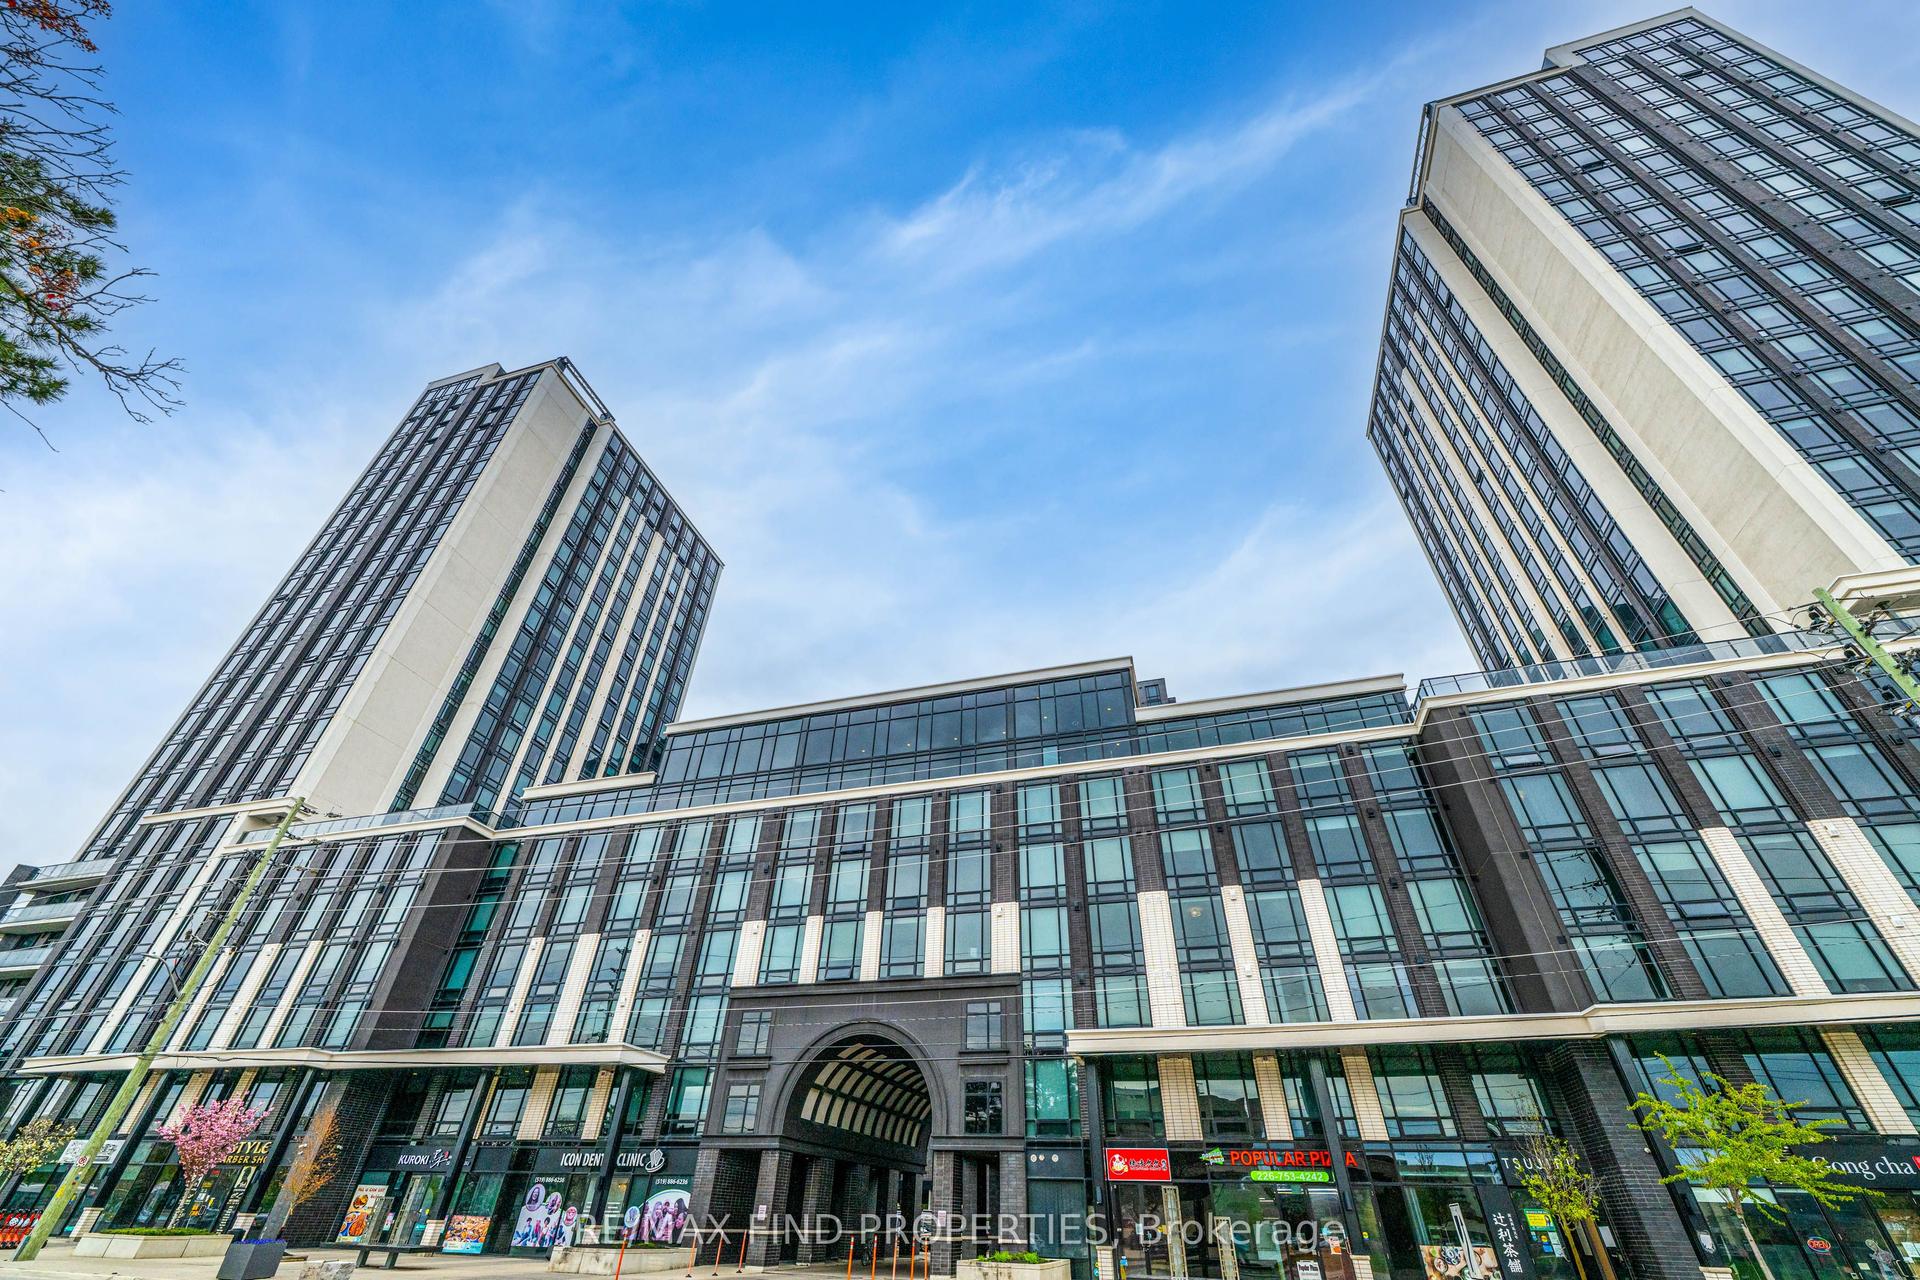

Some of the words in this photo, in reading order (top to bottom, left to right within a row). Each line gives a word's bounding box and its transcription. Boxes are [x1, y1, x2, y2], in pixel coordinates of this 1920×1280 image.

[398, 1155, 430, 1165] KUROKI
[560, 1153, 581, 1166] ICON
[582, 1153, 604, 1166] DENT
[616, 1153, 646, 1166] CLINIC
[1229, 1151, 1305, 1166] POPULAR
[1309, 1151, 1358, 1166] PIZA
[1875, 1156, 1917, 1174] cha
[1256, 1171, 1323, 1182] 226-753-4242
[1808, 1240, 1829, 1250] OPEN
